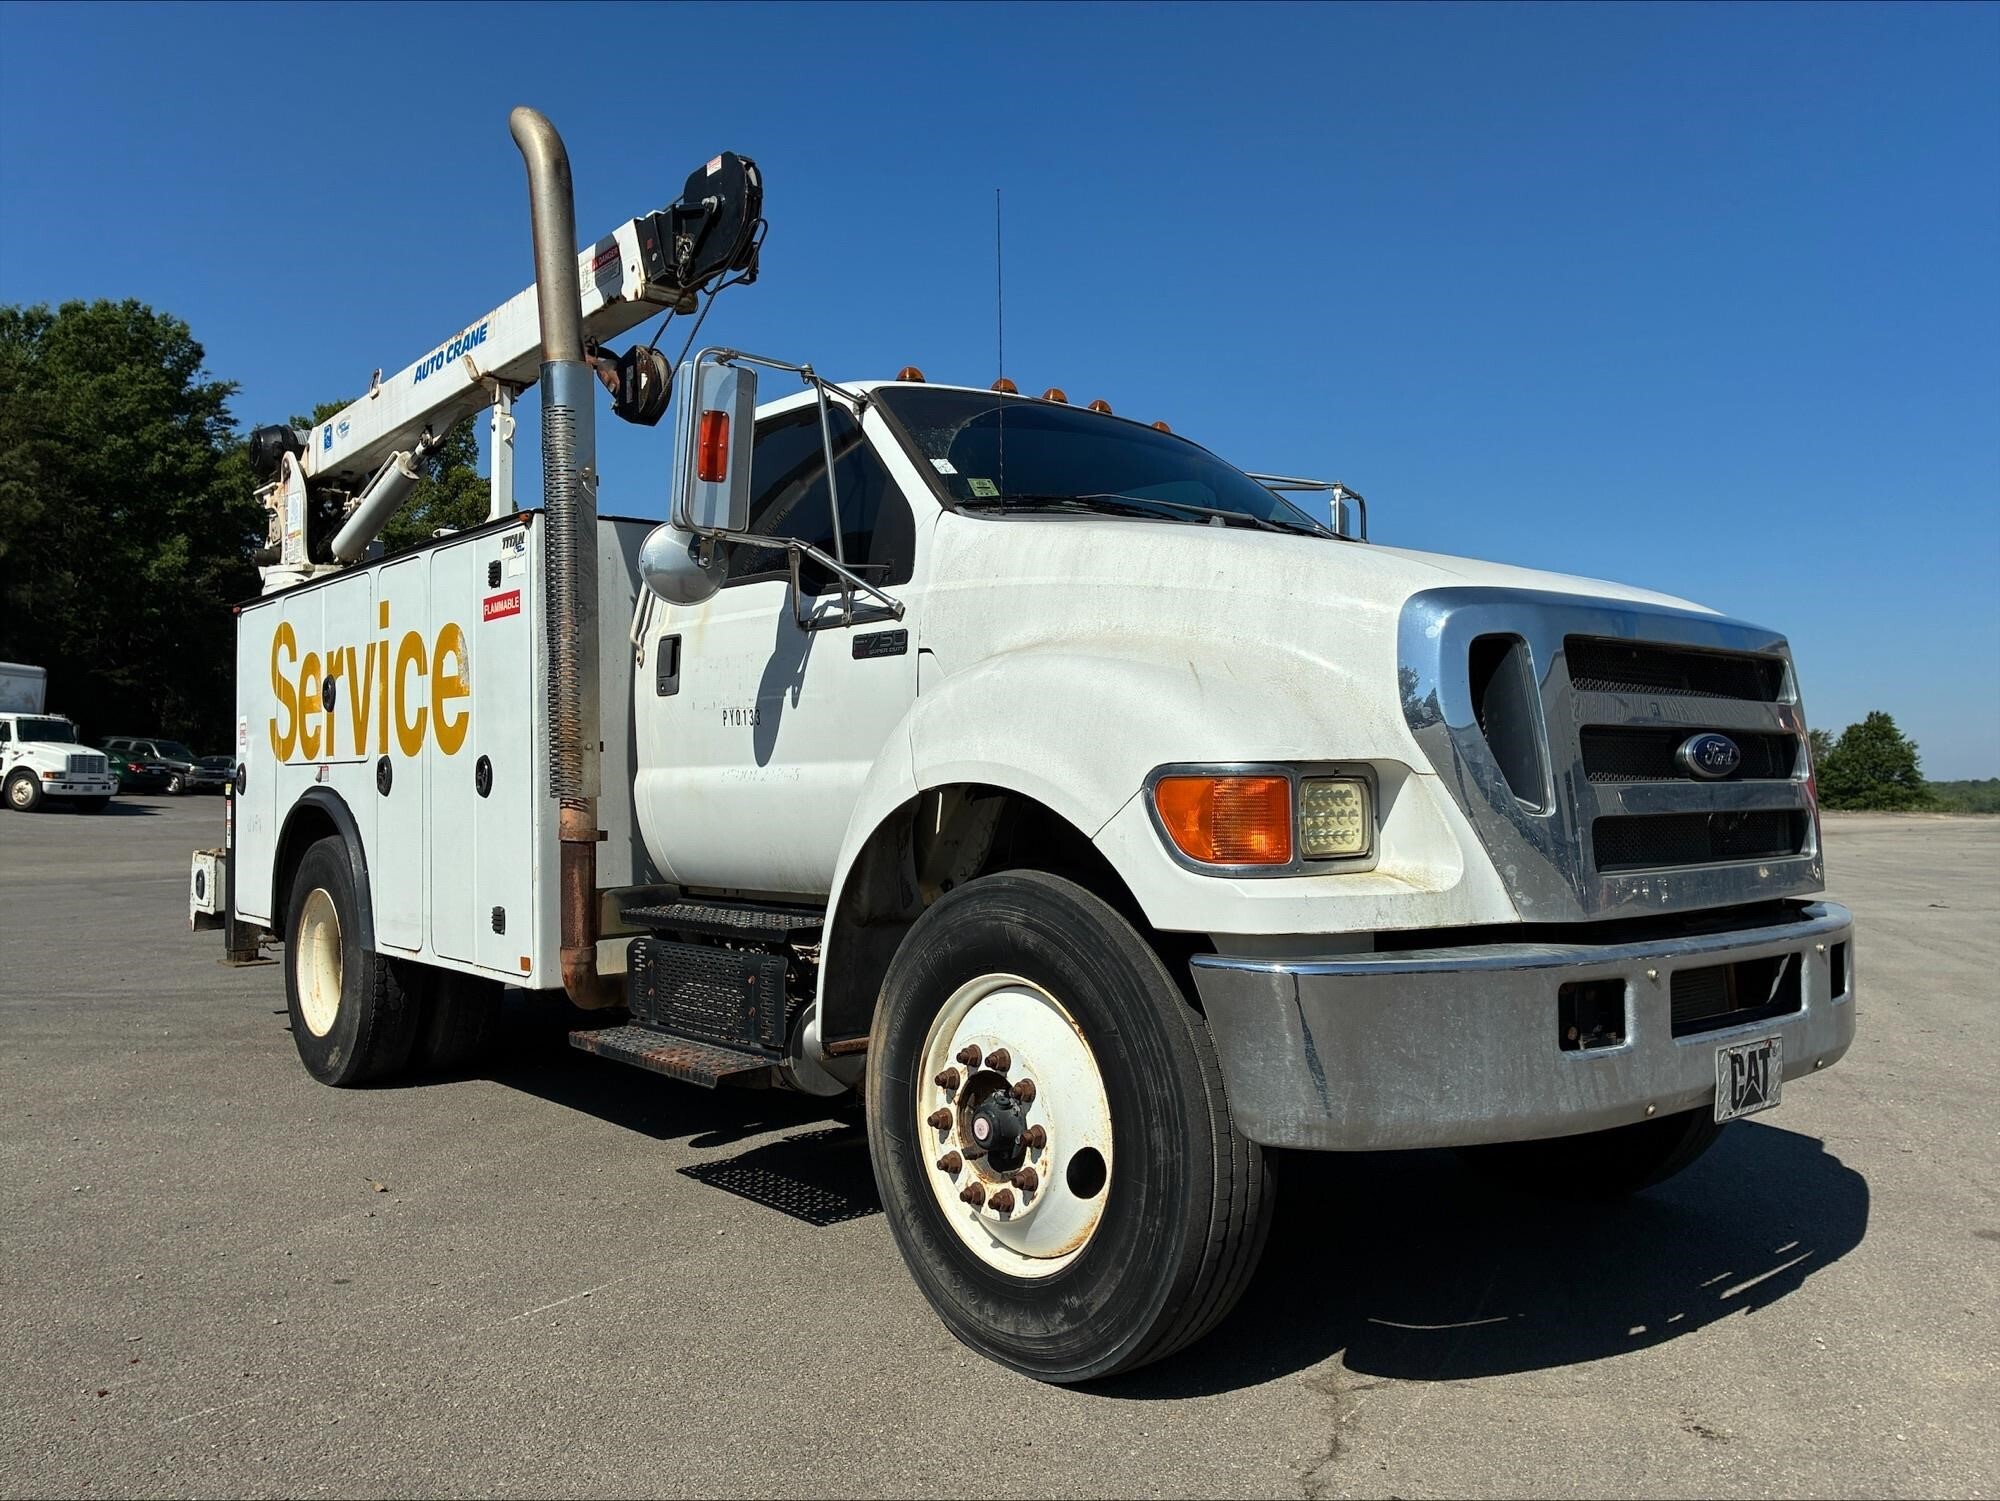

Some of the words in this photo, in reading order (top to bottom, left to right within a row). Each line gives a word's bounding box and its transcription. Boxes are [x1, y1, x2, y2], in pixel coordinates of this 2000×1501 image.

[414, 350, 444, 385] AUTO
[446, 322, 488, 364] CRANE
[502, 532, 525, 550] TITAN
[484, 596, 520, 616] FLAMMABLE
[269, 599, 471, 764] Service
[722, 708, 761, 727] PY0133
[1704, 740, 1734, 765] Ford
[1730, 1046, 1771, 1111] CAT
